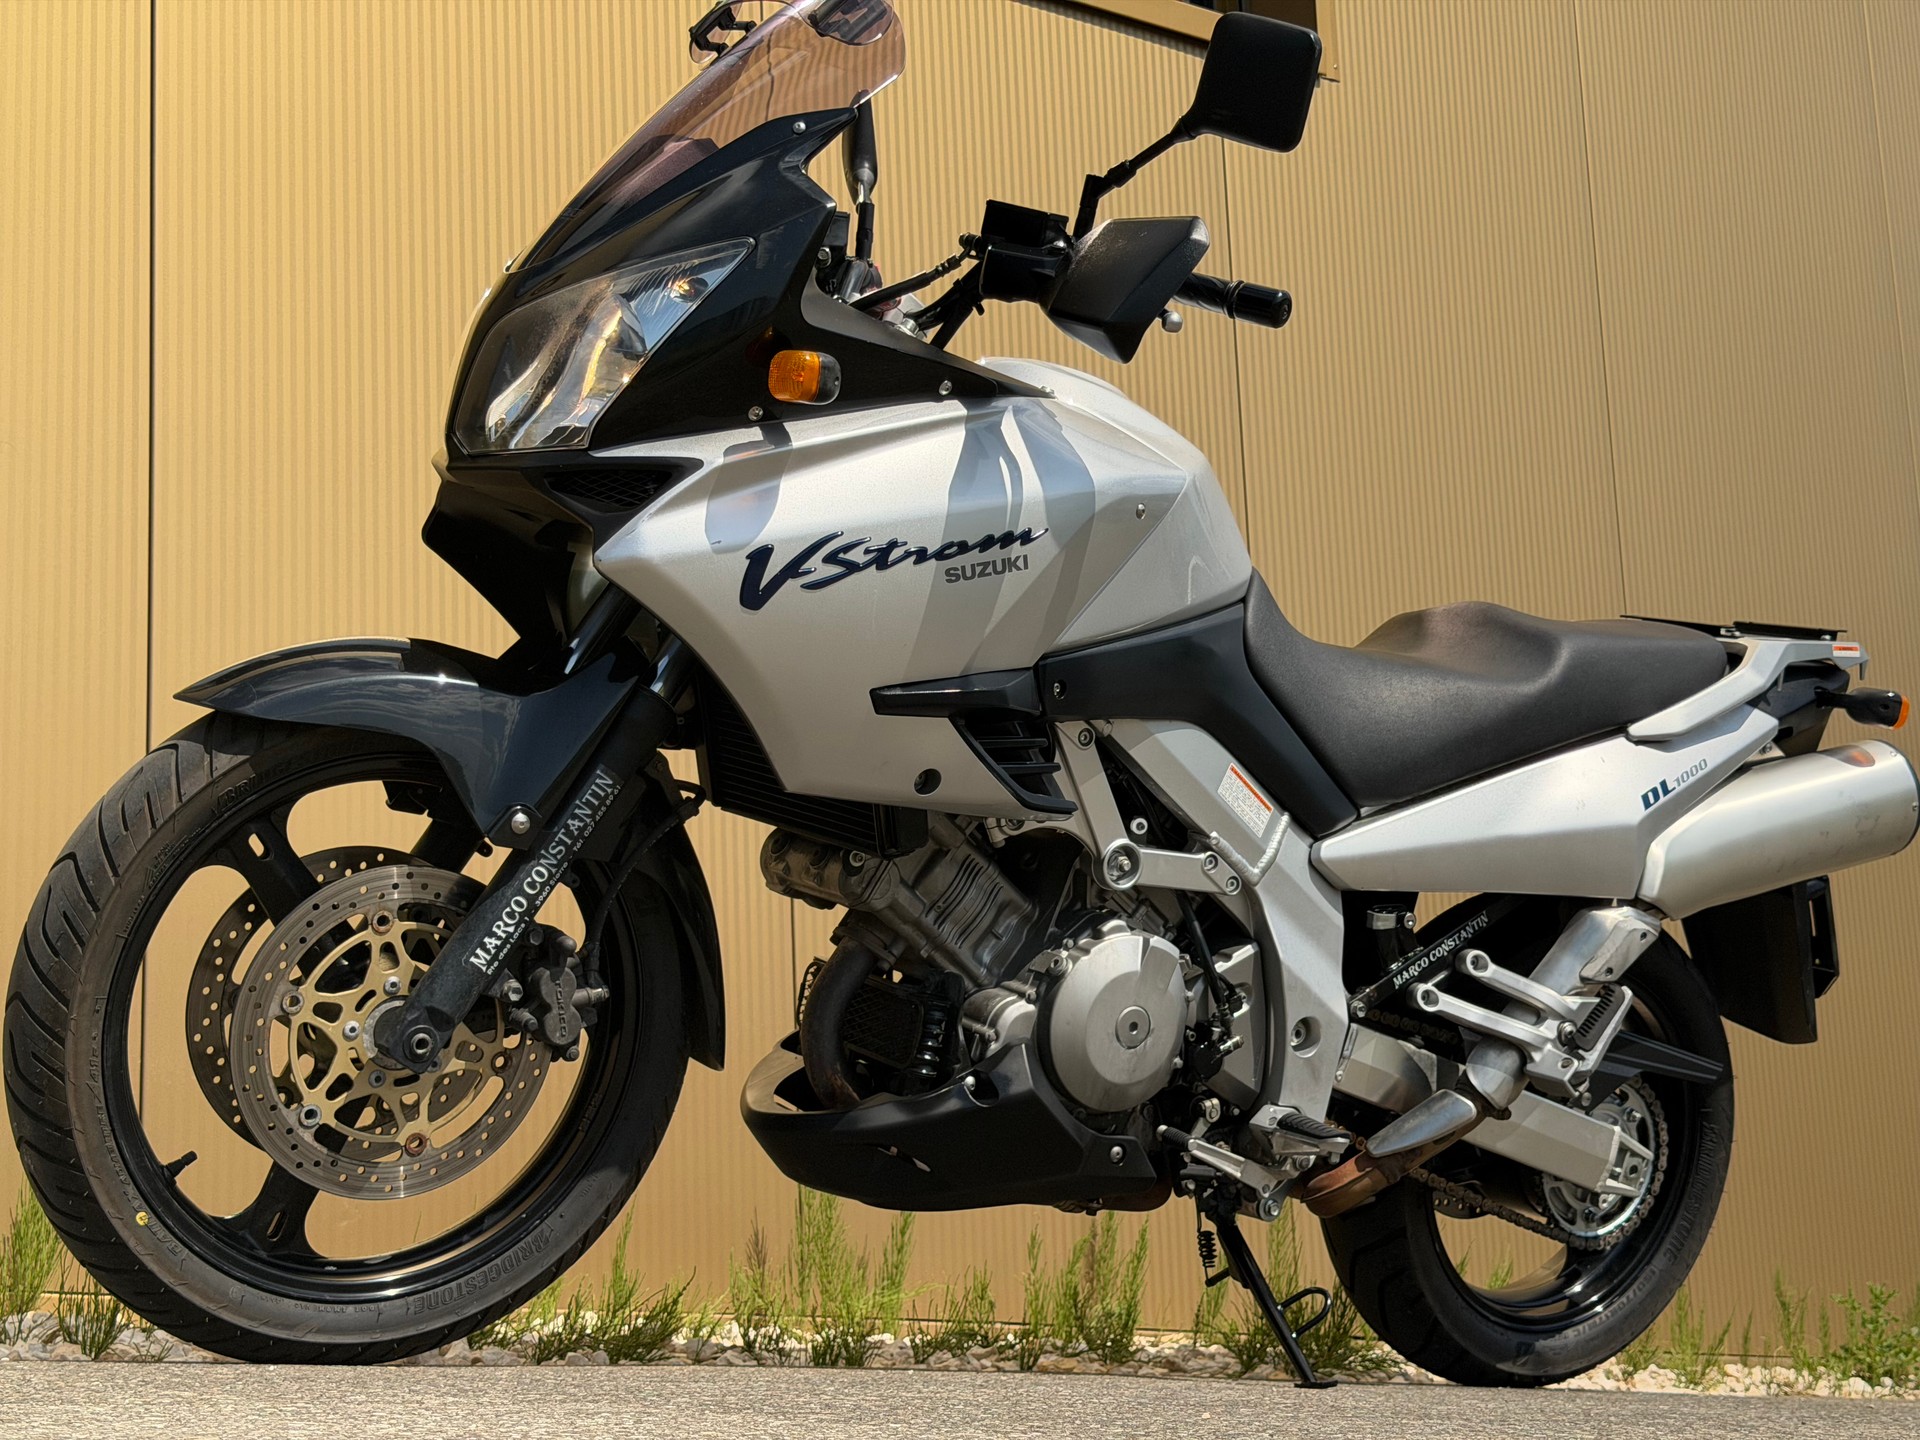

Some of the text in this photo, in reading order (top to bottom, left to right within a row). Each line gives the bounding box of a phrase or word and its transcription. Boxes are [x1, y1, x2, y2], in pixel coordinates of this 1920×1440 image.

[944, 554, 1030, 583] SUZUKI
[469, 769, 614, 973] MARCO CONSTANTIN
[498, 943, 511, 960] des
[509, 923, 526, 943] Lacs
[534, 885, 551, 907] 3960
[549, 861, 569, 886] Sierre
[583, 821, 595, 837] 027
[1392, 910, 1489, 989] MARCO CONSTANTIN
[413, 1232, 551, 1315] BRIDGESTONE
